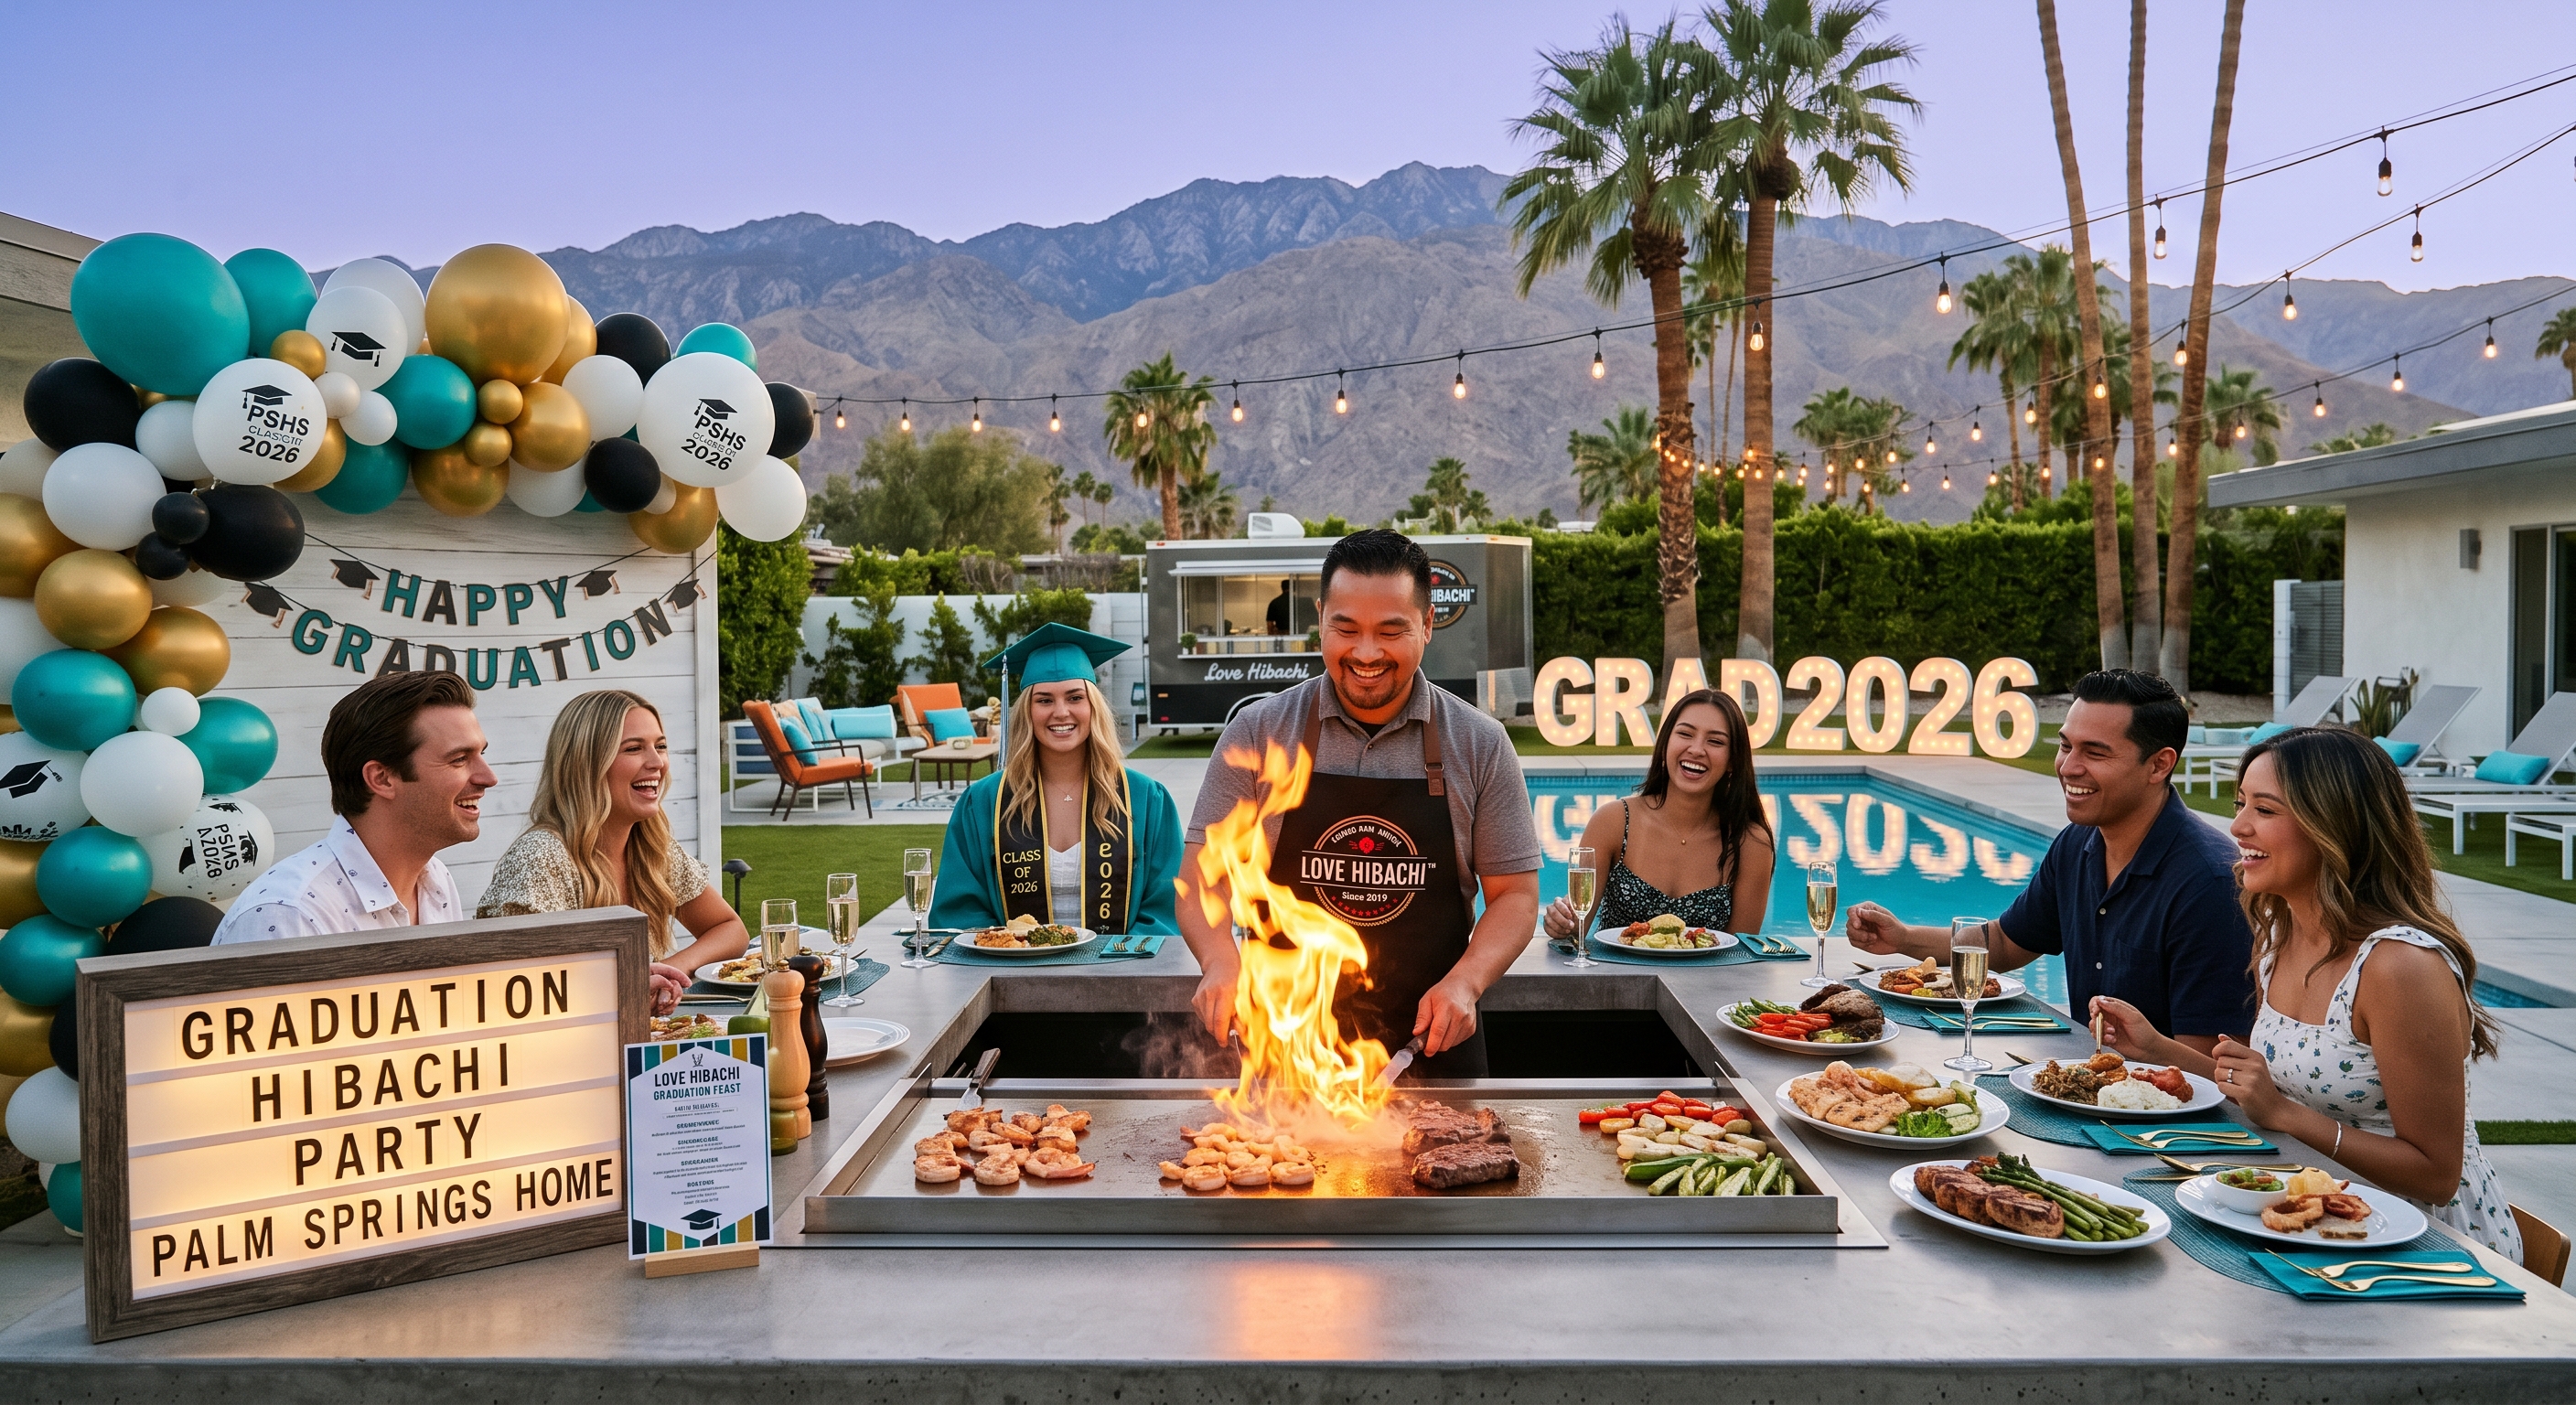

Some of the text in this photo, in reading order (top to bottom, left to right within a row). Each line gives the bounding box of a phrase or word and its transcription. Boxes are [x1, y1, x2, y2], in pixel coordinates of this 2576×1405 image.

[247, 404, 310, 435] PSHS
[694, 414, 746, 451] PSHS
[239, 434, 300, 464] 2026
[681, 438, 733, 470] 2026
[381, 567, 570, 627] HAPPY
[291, 597, 673, 692] GRADUATION
[1204, 662, 1310, 682] Love Hibachi
[1003, 849, 1042, 864] CLASS
[1301, 855, 1346, 883] LOVE
[1351, 861, 1426, 885] HIBACHI
[1014, 866, 1031, 879] OF
[1011, 881, 1038, 895] 2026
[1366, 893, 1389, 903] 2019
[181, 969, 570, 1061] GRADUATION
[252, 1043, 510, 1122] HIBACHI
[653, 1082, 742, 1101] GRADUATION FEAST
[654, 1066, 740, 1088] LOVE HIBACHI
[295, 1112, 483, 1186] PARTY
[152, 1158, 615, 1277] PALM SPRINGS HOME
